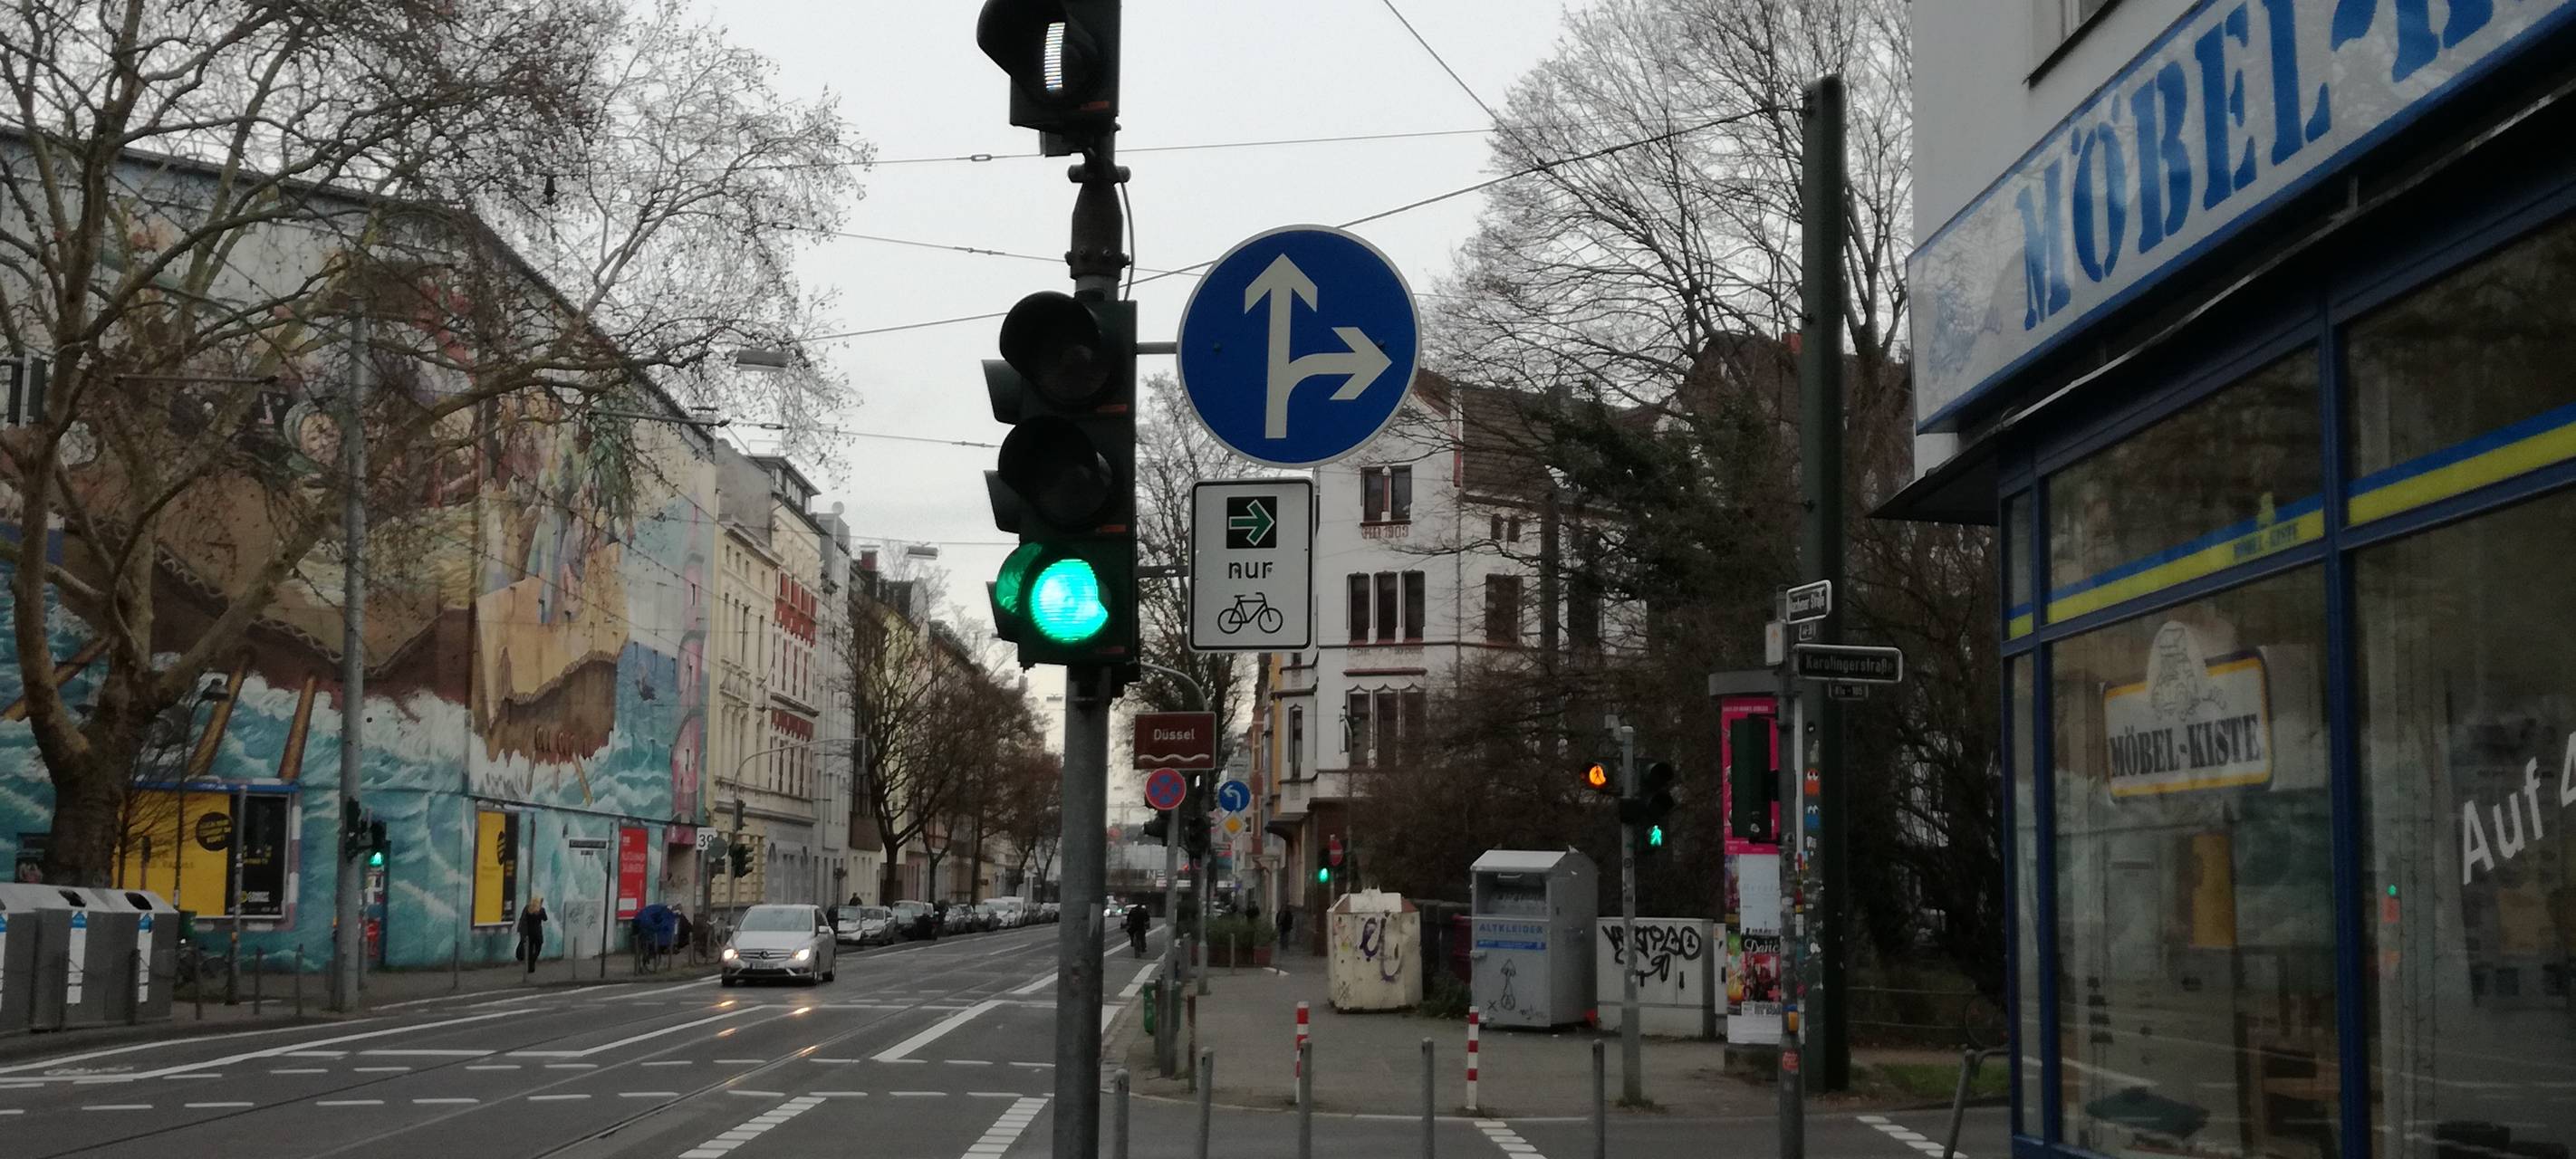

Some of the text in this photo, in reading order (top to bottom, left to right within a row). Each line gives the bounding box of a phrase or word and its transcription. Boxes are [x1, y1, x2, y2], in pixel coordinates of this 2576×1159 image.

[1154, 728, 1196, 741] Düssel
[2110, 714, 2261, 778] MÖBEL-KISTE
[2464, 756, 2544, 886] Auf
[1478, 924, 1543, 934] ALTKLEIDER
